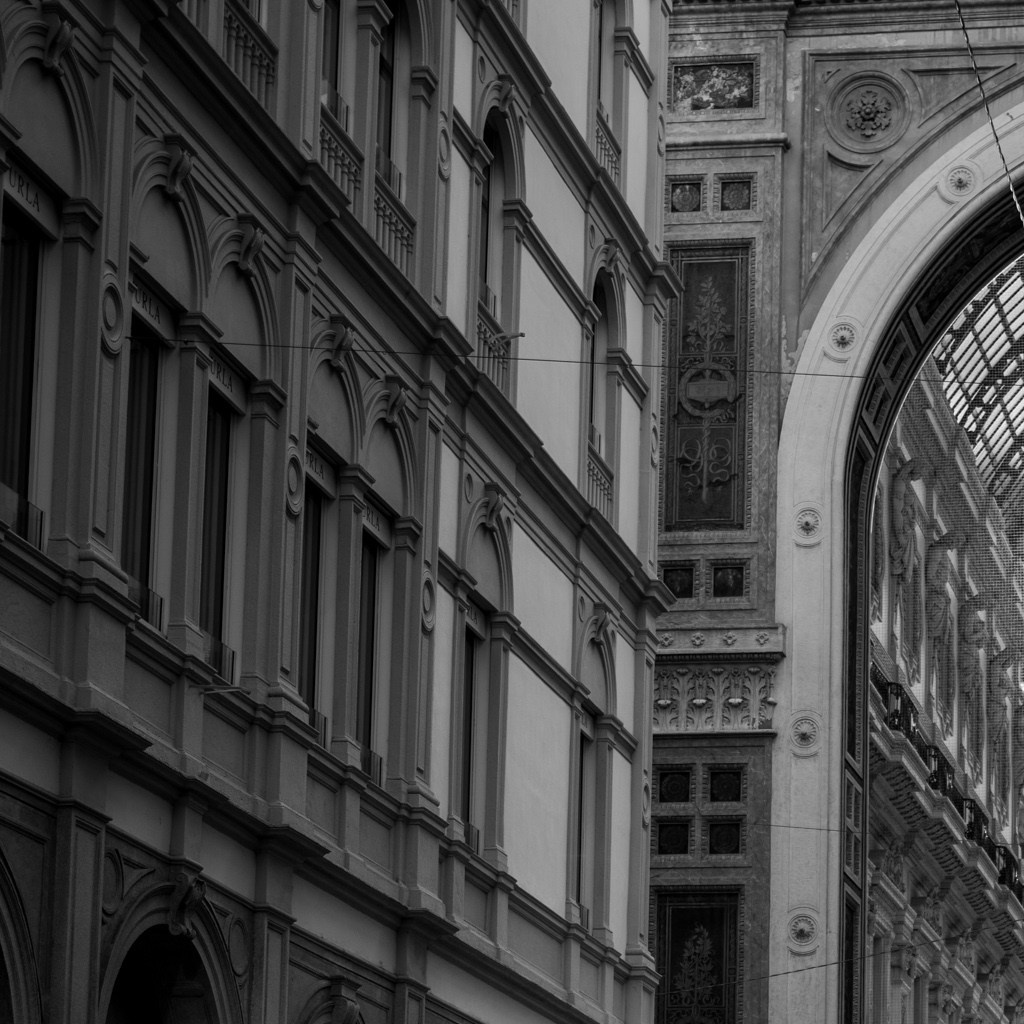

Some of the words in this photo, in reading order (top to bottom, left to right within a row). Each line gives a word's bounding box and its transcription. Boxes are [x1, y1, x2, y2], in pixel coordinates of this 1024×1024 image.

[8, 165, 40, 212] URLA
[135, 288, 160, 325] URLA
[210, 357, 233, 393] URLA
